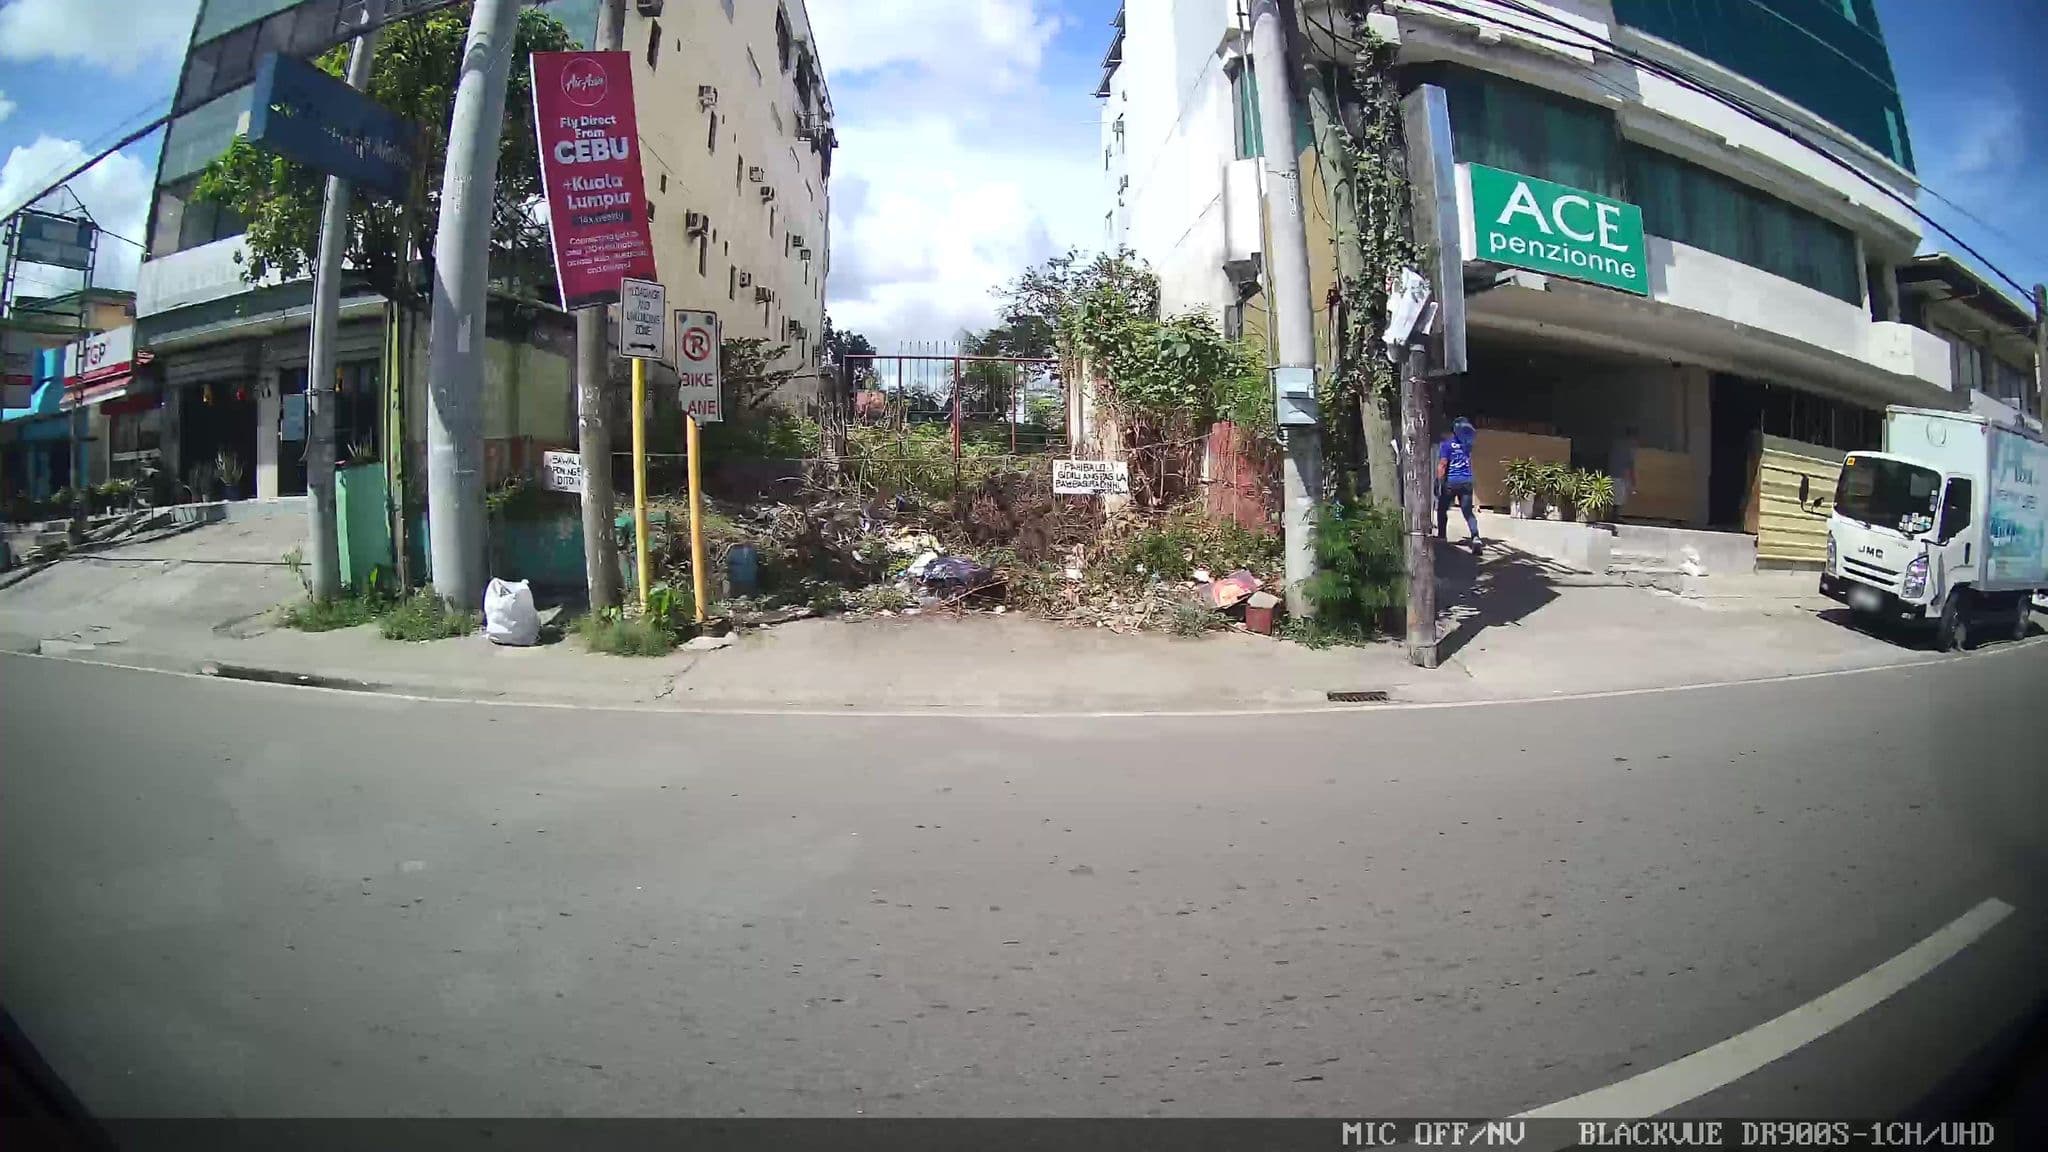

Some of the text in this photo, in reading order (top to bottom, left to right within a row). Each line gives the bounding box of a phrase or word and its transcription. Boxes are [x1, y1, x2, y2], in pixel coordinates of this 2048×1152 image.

[560, 115, 617, 129] Fly Direct
[575, 128, 605, 139] From
[554, 137, 629, 165] CEBU
[567, 192, 632, 210] Lumpur
[1496, 181, 1629, 253] ACE
[1489, 231, 1637, 279] penzionne
[681, 372, 714, 388] BIKE
[1858, 545, 1884, 559] JMC
